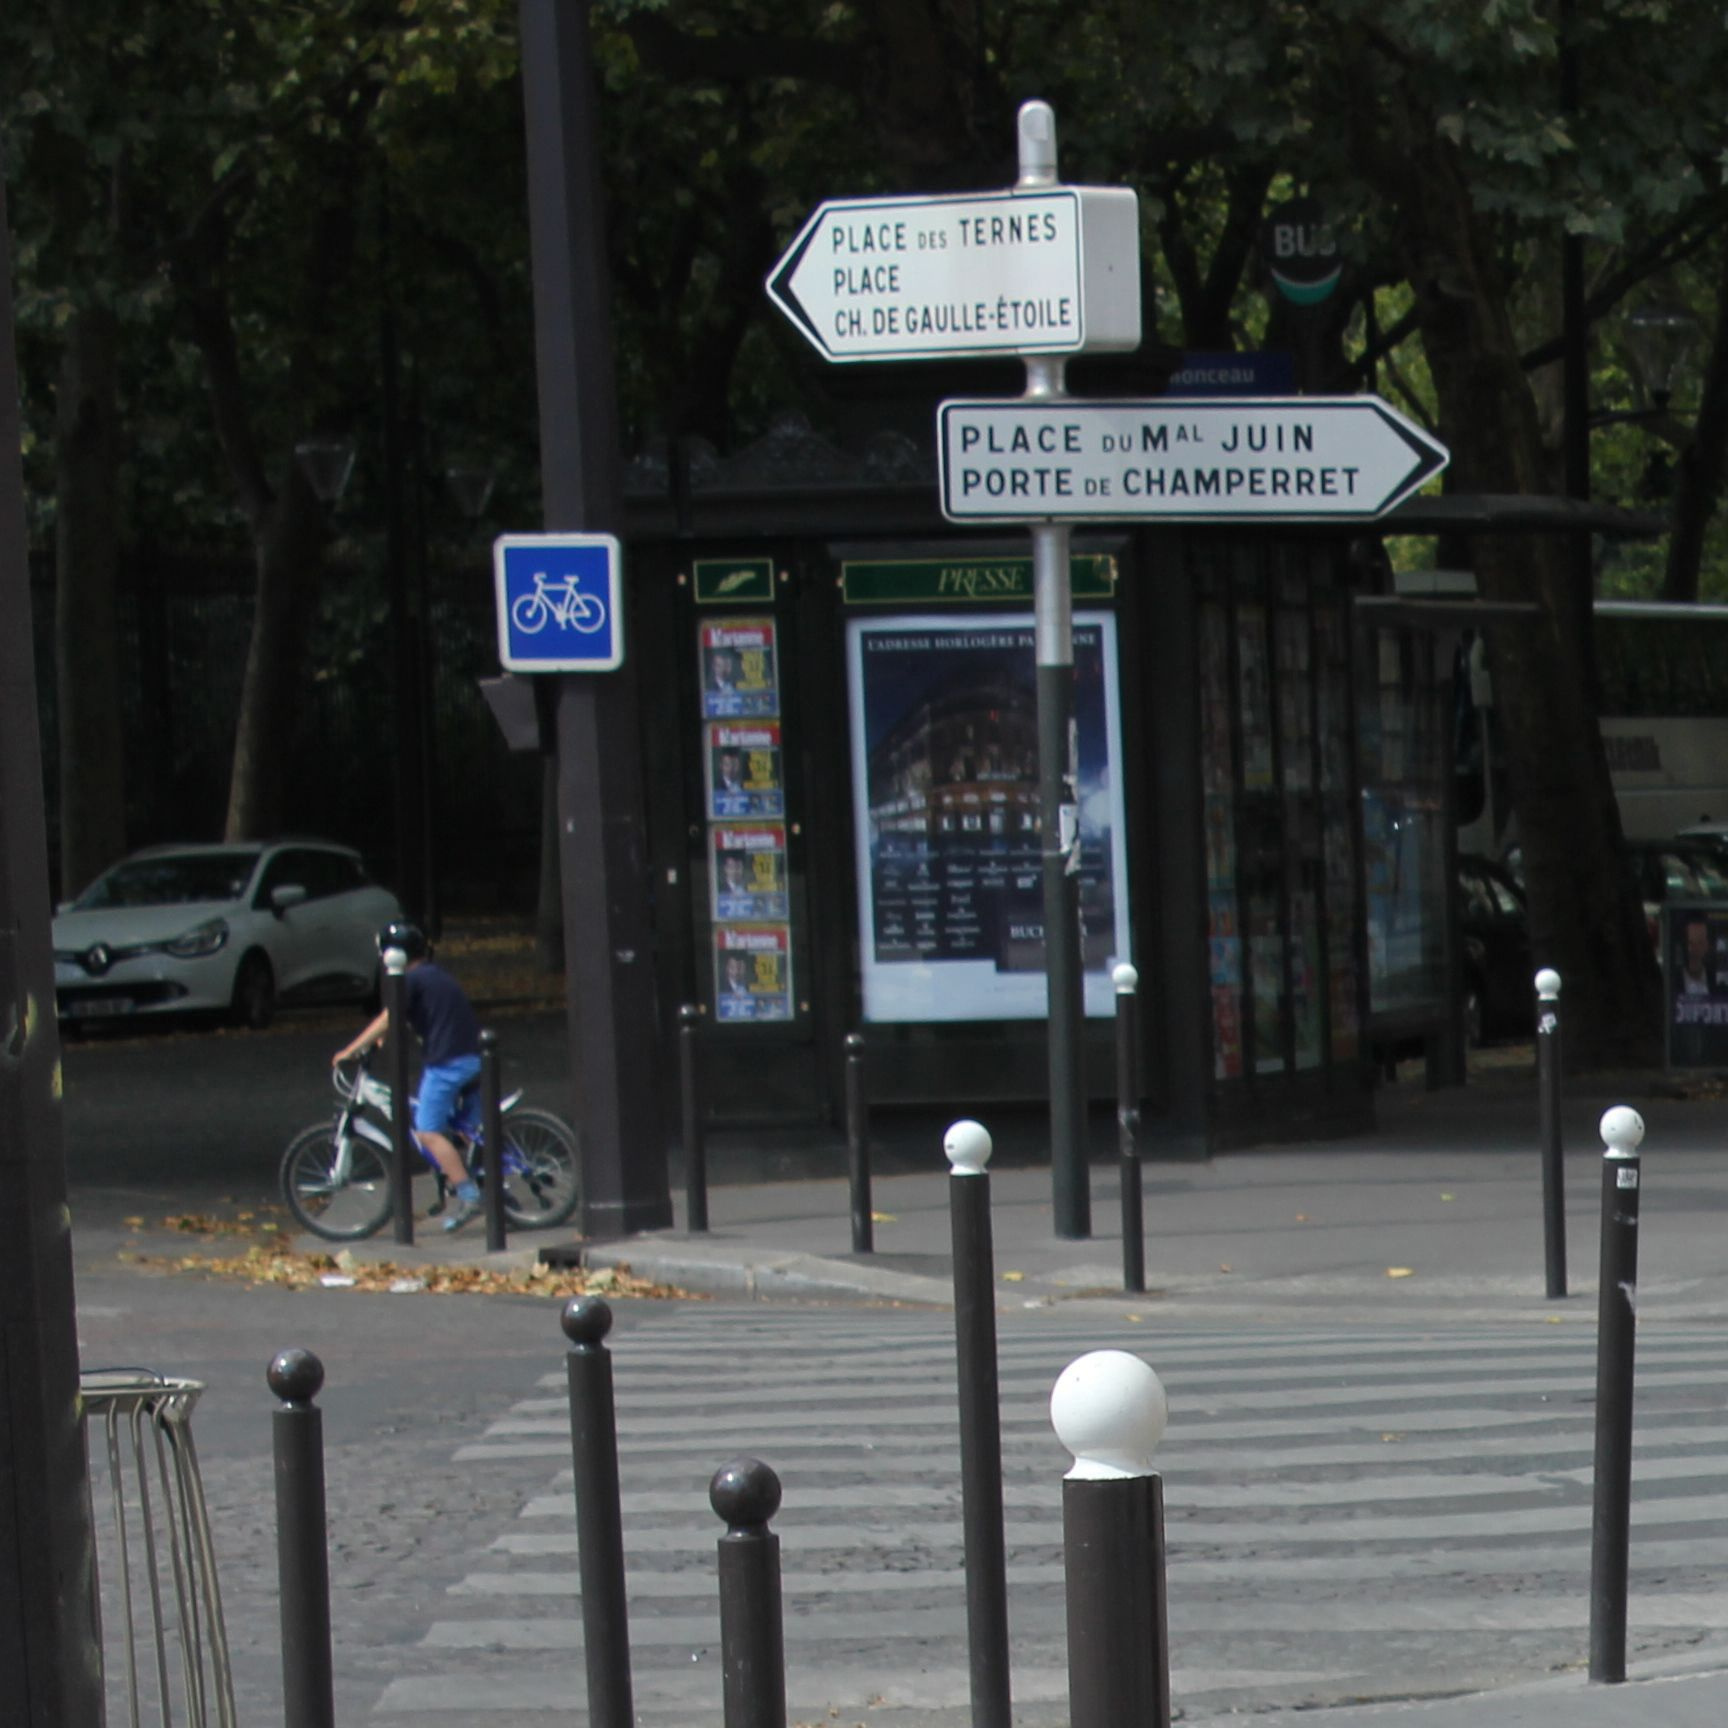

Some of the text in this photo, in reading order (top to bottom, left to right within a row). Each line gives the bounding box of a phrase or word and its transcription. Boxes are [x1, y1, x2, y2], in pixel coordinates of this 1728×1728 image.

[832, 213, 1056, 254] PLACE DES TERNES
[833, 265, 901, 295] PLACE
[834, 296, 1072, 336] CH. DE GAULLE-ÉTOILE
[961, 425, 1082, 453] PLACE
[1103, 434, 1132, 453] DU
[1221, 424, 1315, 453] JUIN
[962, 467, 1361, 496] PORTE DE CHAMPERRET
[937, 566, 1024, 599] PRESSE
